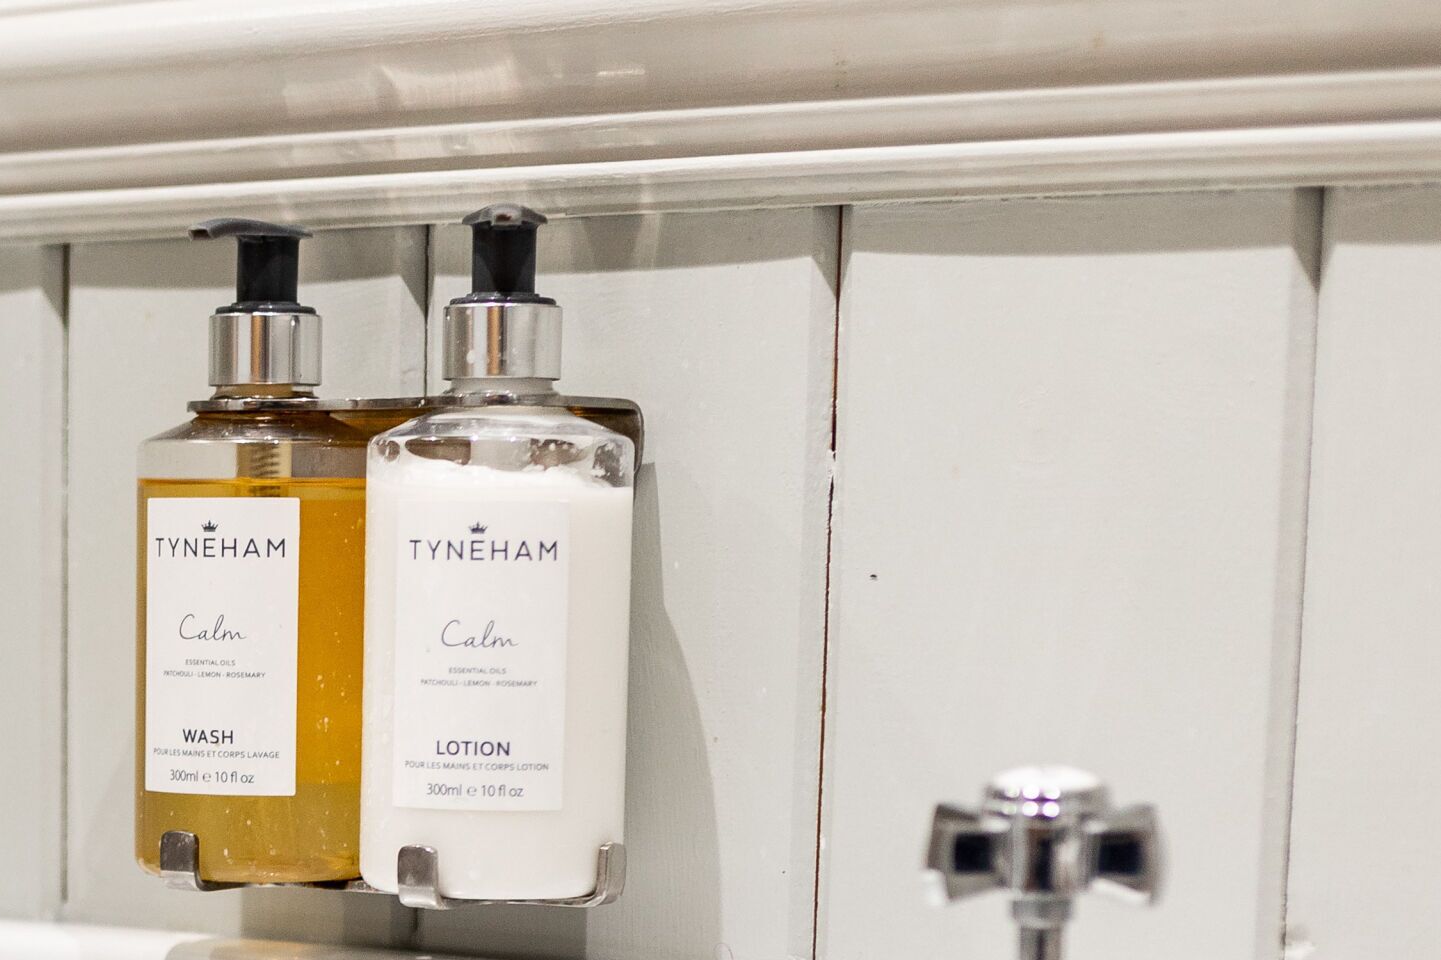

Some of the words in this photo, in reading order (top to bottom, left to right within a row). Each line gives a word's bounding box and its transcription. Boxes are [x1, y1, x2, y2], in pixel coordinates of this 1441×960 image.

[155, 538, 285, 558] TYNEHAM
[409, 540, 558, 561] TYNEHAM
[179, 613, 247, 641] Calm
[441, 619, 518, 648] Calm
[182, 729, 234, 744] WASH
[436, 740, 510, 756] LOTION
[405, 760, 424, 768] POUR
[443, 762, 470, 770] MAINS
[484, 763, 515, 771] CORPS
[170, 769, 198, 782] 300ml
[215, 771, 228, 783] 10
[230, 772, 237, 783] fl
[241, 774, 255, 784] oz
[427, 783, 462, 796] 300ml
[481, 785, 495, 797] 10
[498, 785, 506, 797] fl
[509, 788, 524, 797] oz
